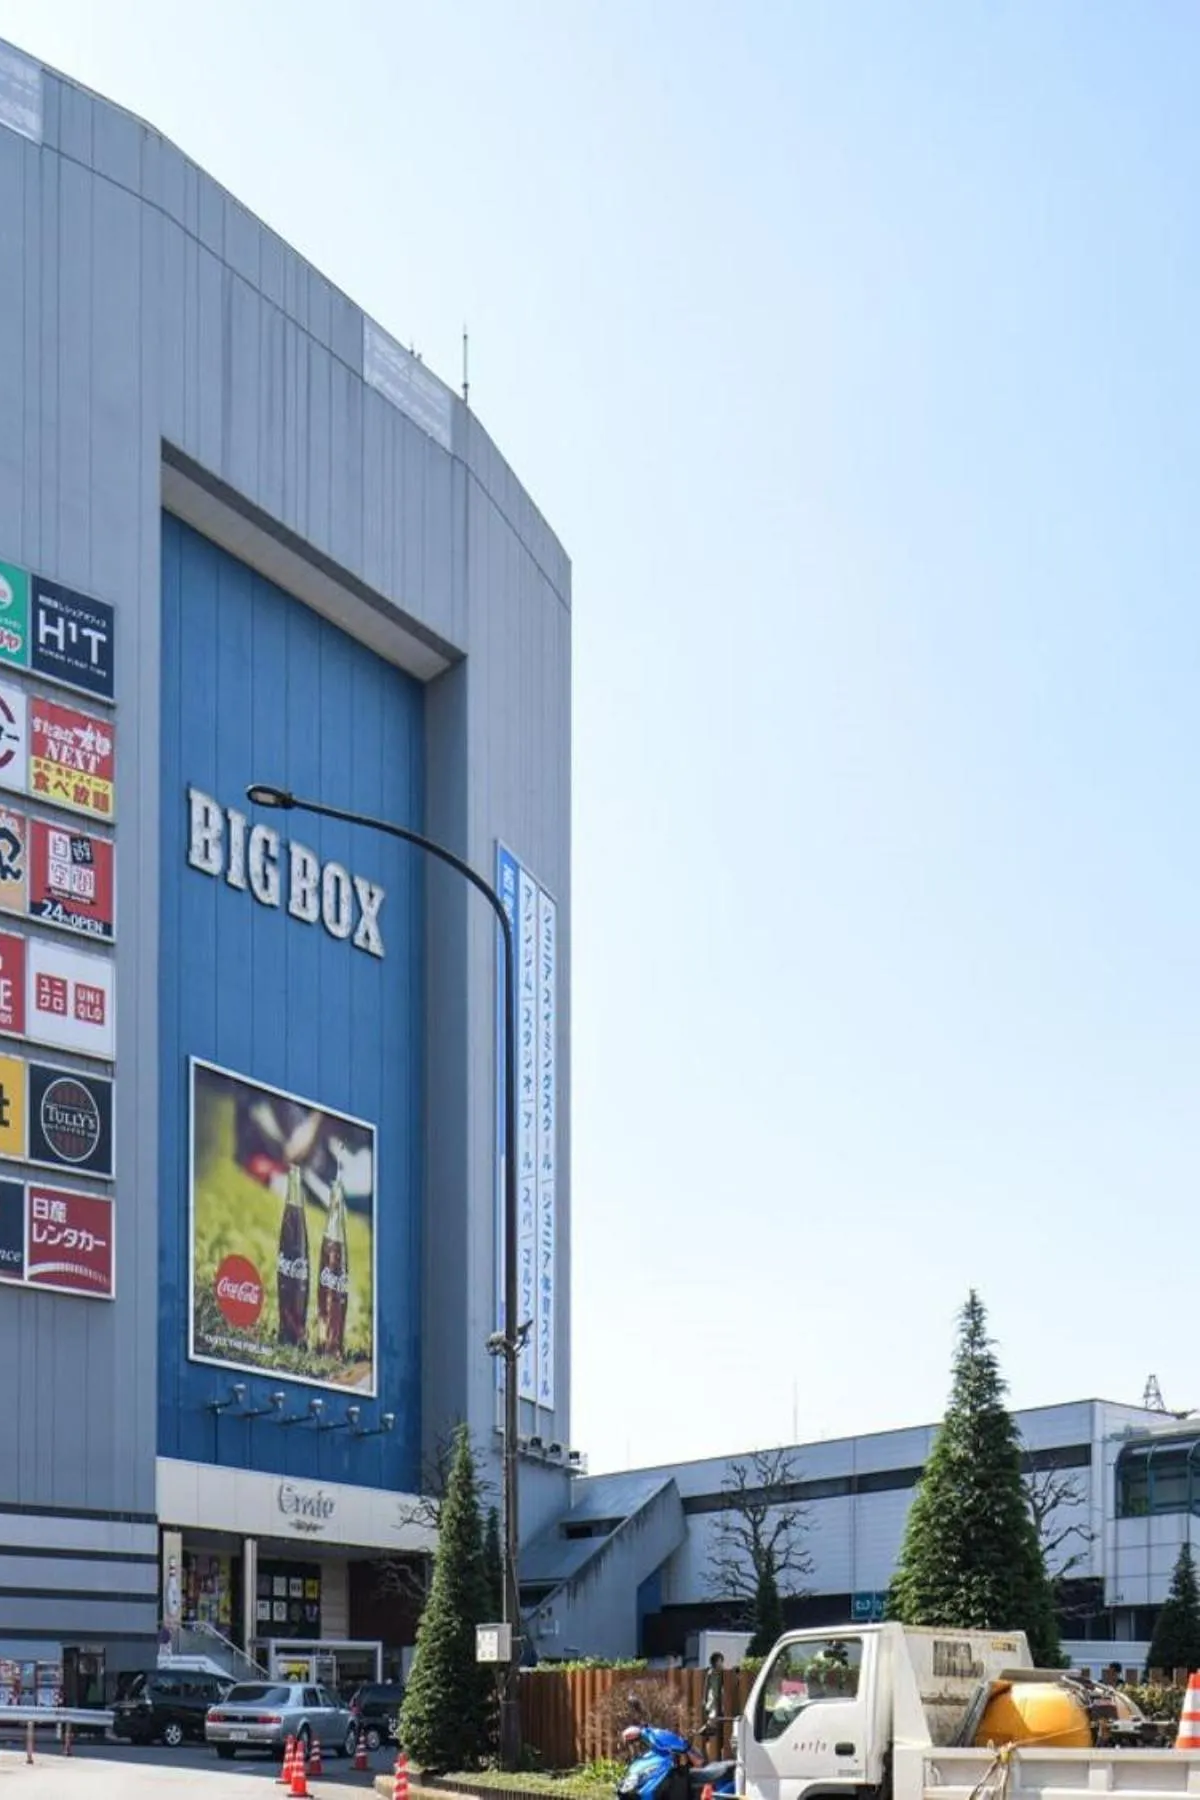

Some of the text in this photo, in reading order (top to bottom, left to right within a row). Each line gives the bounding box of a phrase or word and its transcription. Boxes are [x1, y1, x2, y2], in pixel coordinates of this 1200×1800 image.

[45, 738, 101, 774] NEXT
[188, 787, 280, 909] BIG
[288, 840, 385, 958] BOX
[77, 987, 102, 1003] UNI
[77, 1004, 103, 1021] QLO
[32, 1197, 67, 1224] 日産
[32, 1222, 107, 1251] レンタカー
